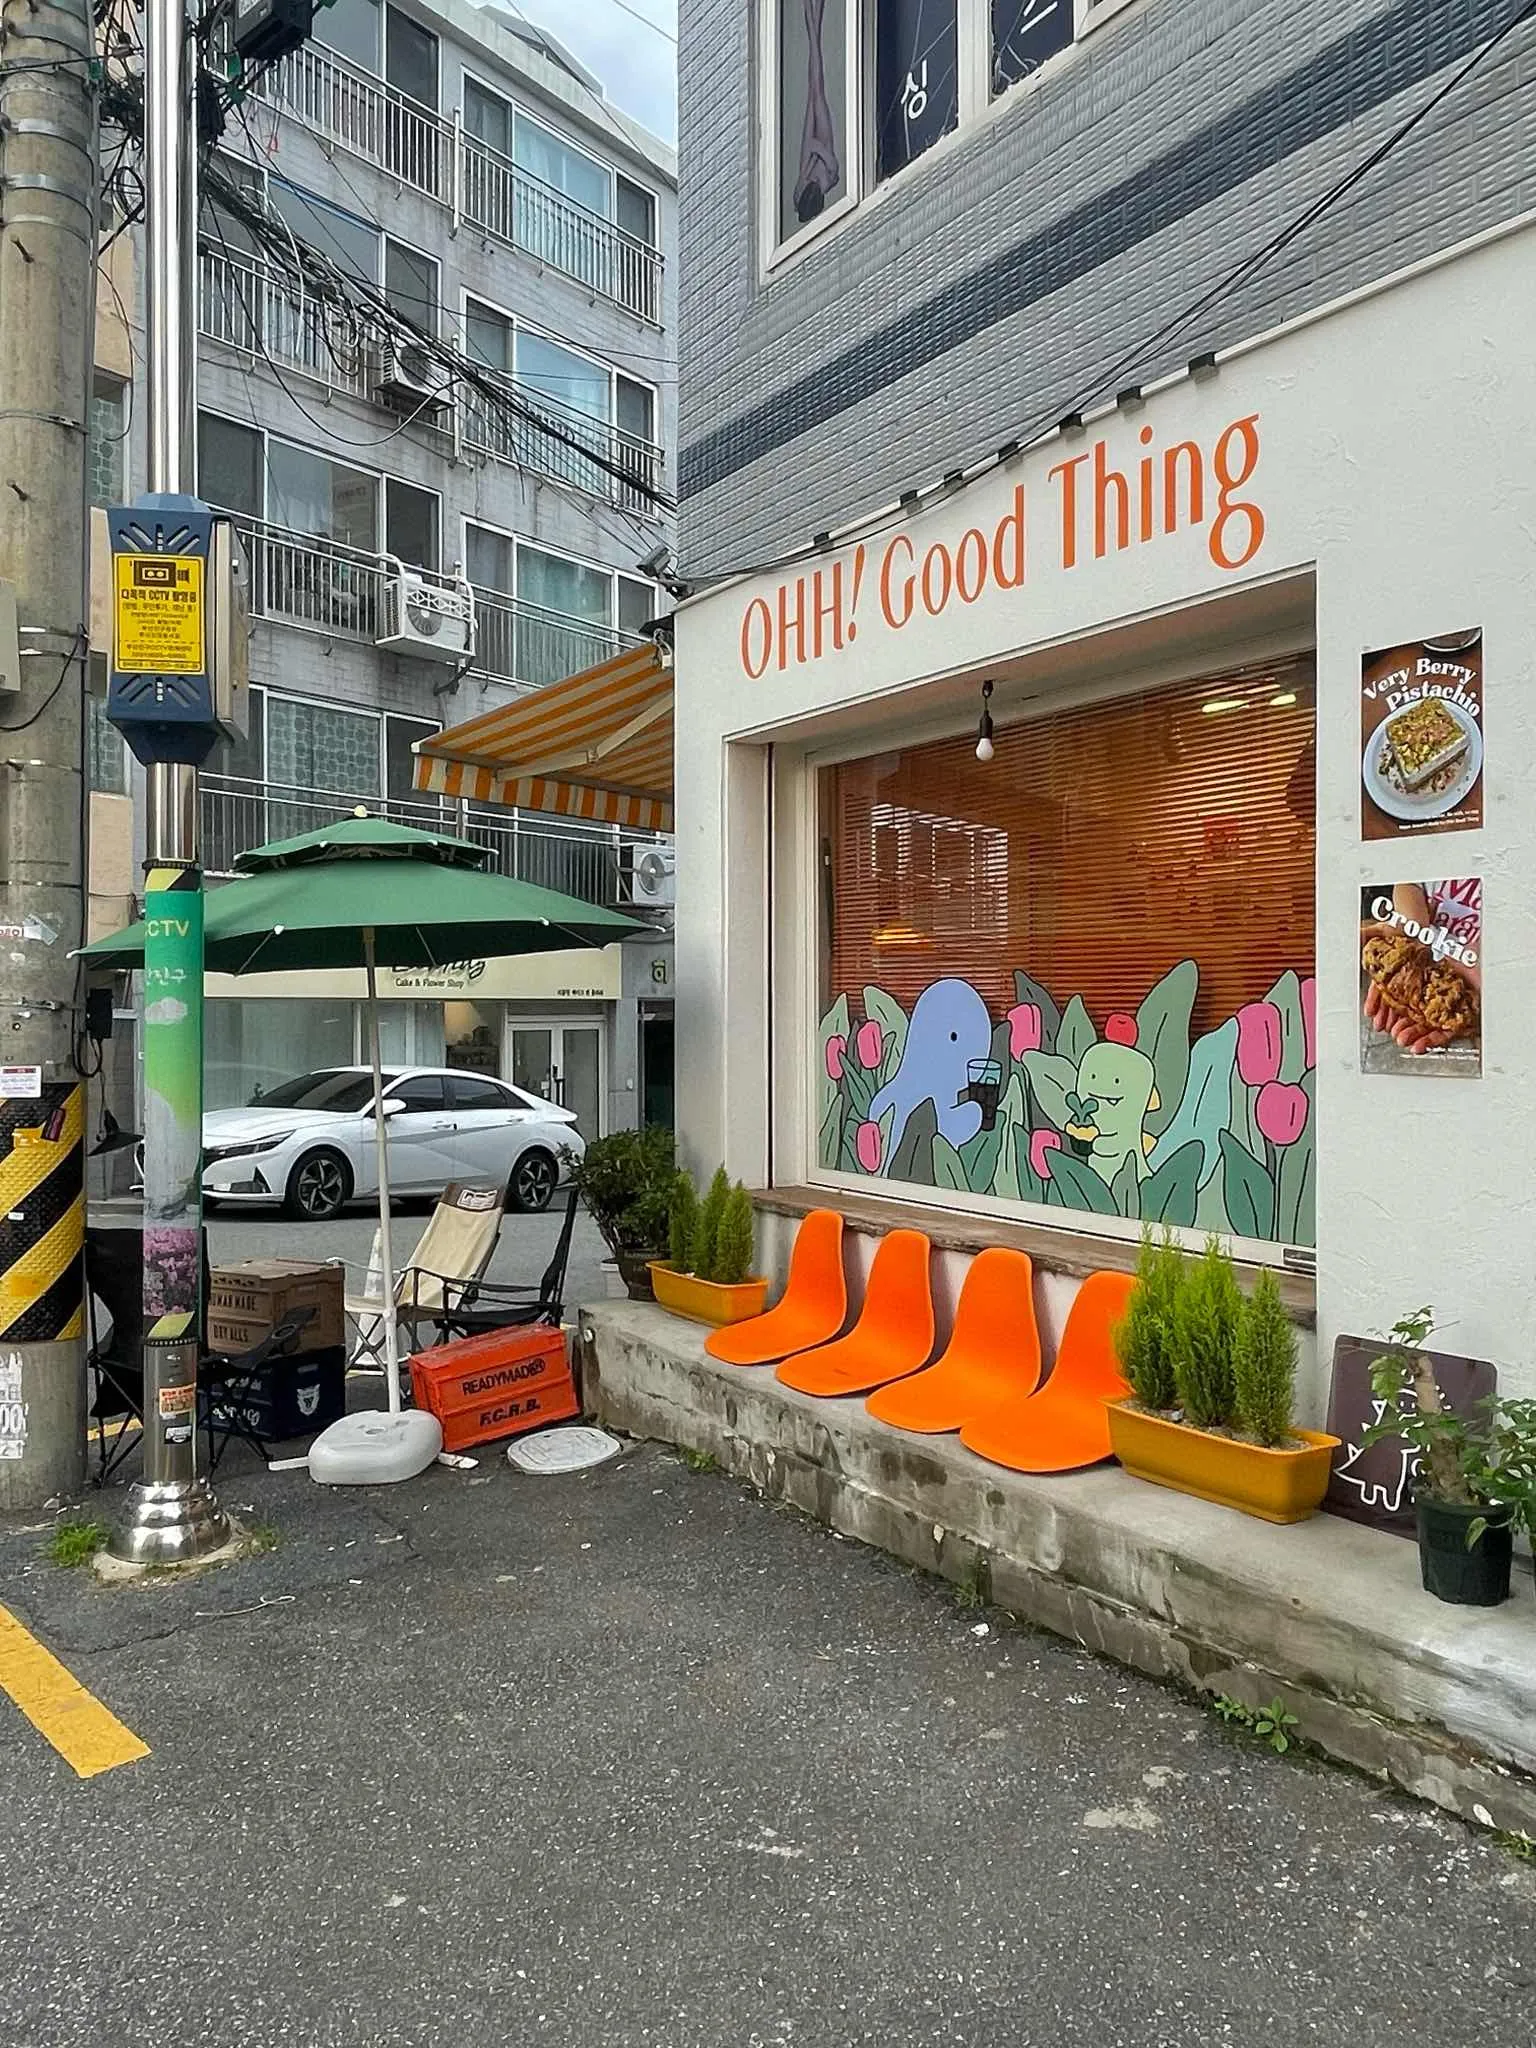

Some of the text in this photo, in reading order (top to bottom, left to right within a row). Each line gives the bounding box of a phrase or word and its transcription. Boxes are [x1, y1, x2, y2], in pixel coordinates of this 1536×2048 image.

[741, 413, 1265, 680] OHH! Good Thing
[148, 590, 169, 601] CCTV
[1363, 657, 1477, 700] Very Berry
[1385, 680, 1480, 717] Pistachio
[145, 919, 190, 937] CTV
[1371, 896, 1478, 968] Crookie
[396, 978, 413, 987] Cake
[423, 978, 446, 987] Flower
